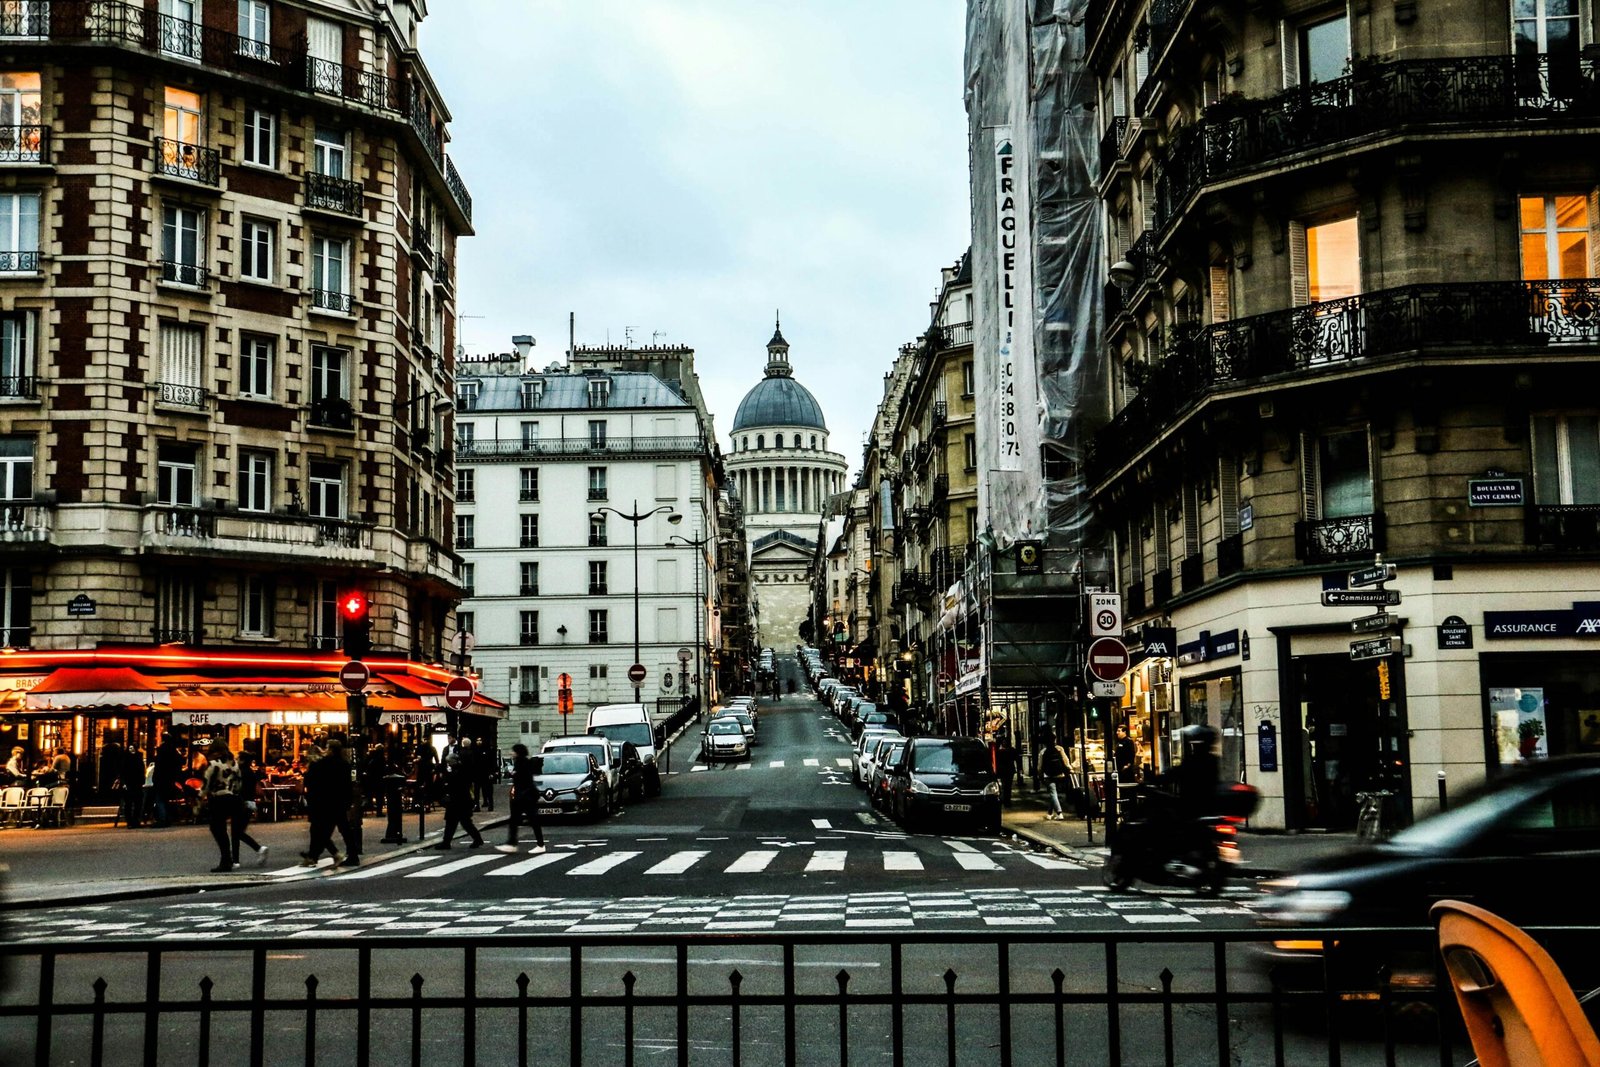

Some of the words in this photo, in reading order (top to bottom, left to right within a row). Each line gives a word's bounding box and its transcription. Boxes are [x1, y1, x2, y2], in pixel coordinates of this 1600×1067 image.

[1001, 157, 1015, 327] FRAQUELLI
[1096, 598, 1116, 606] ZONE
[1100, 615, 1113, 625] 30
[1493, 623, 1557, 633] ASSURANCE
[1145, 642, 1168, 654] AXA
[391, 714, 432, 723] RESTAURANT
